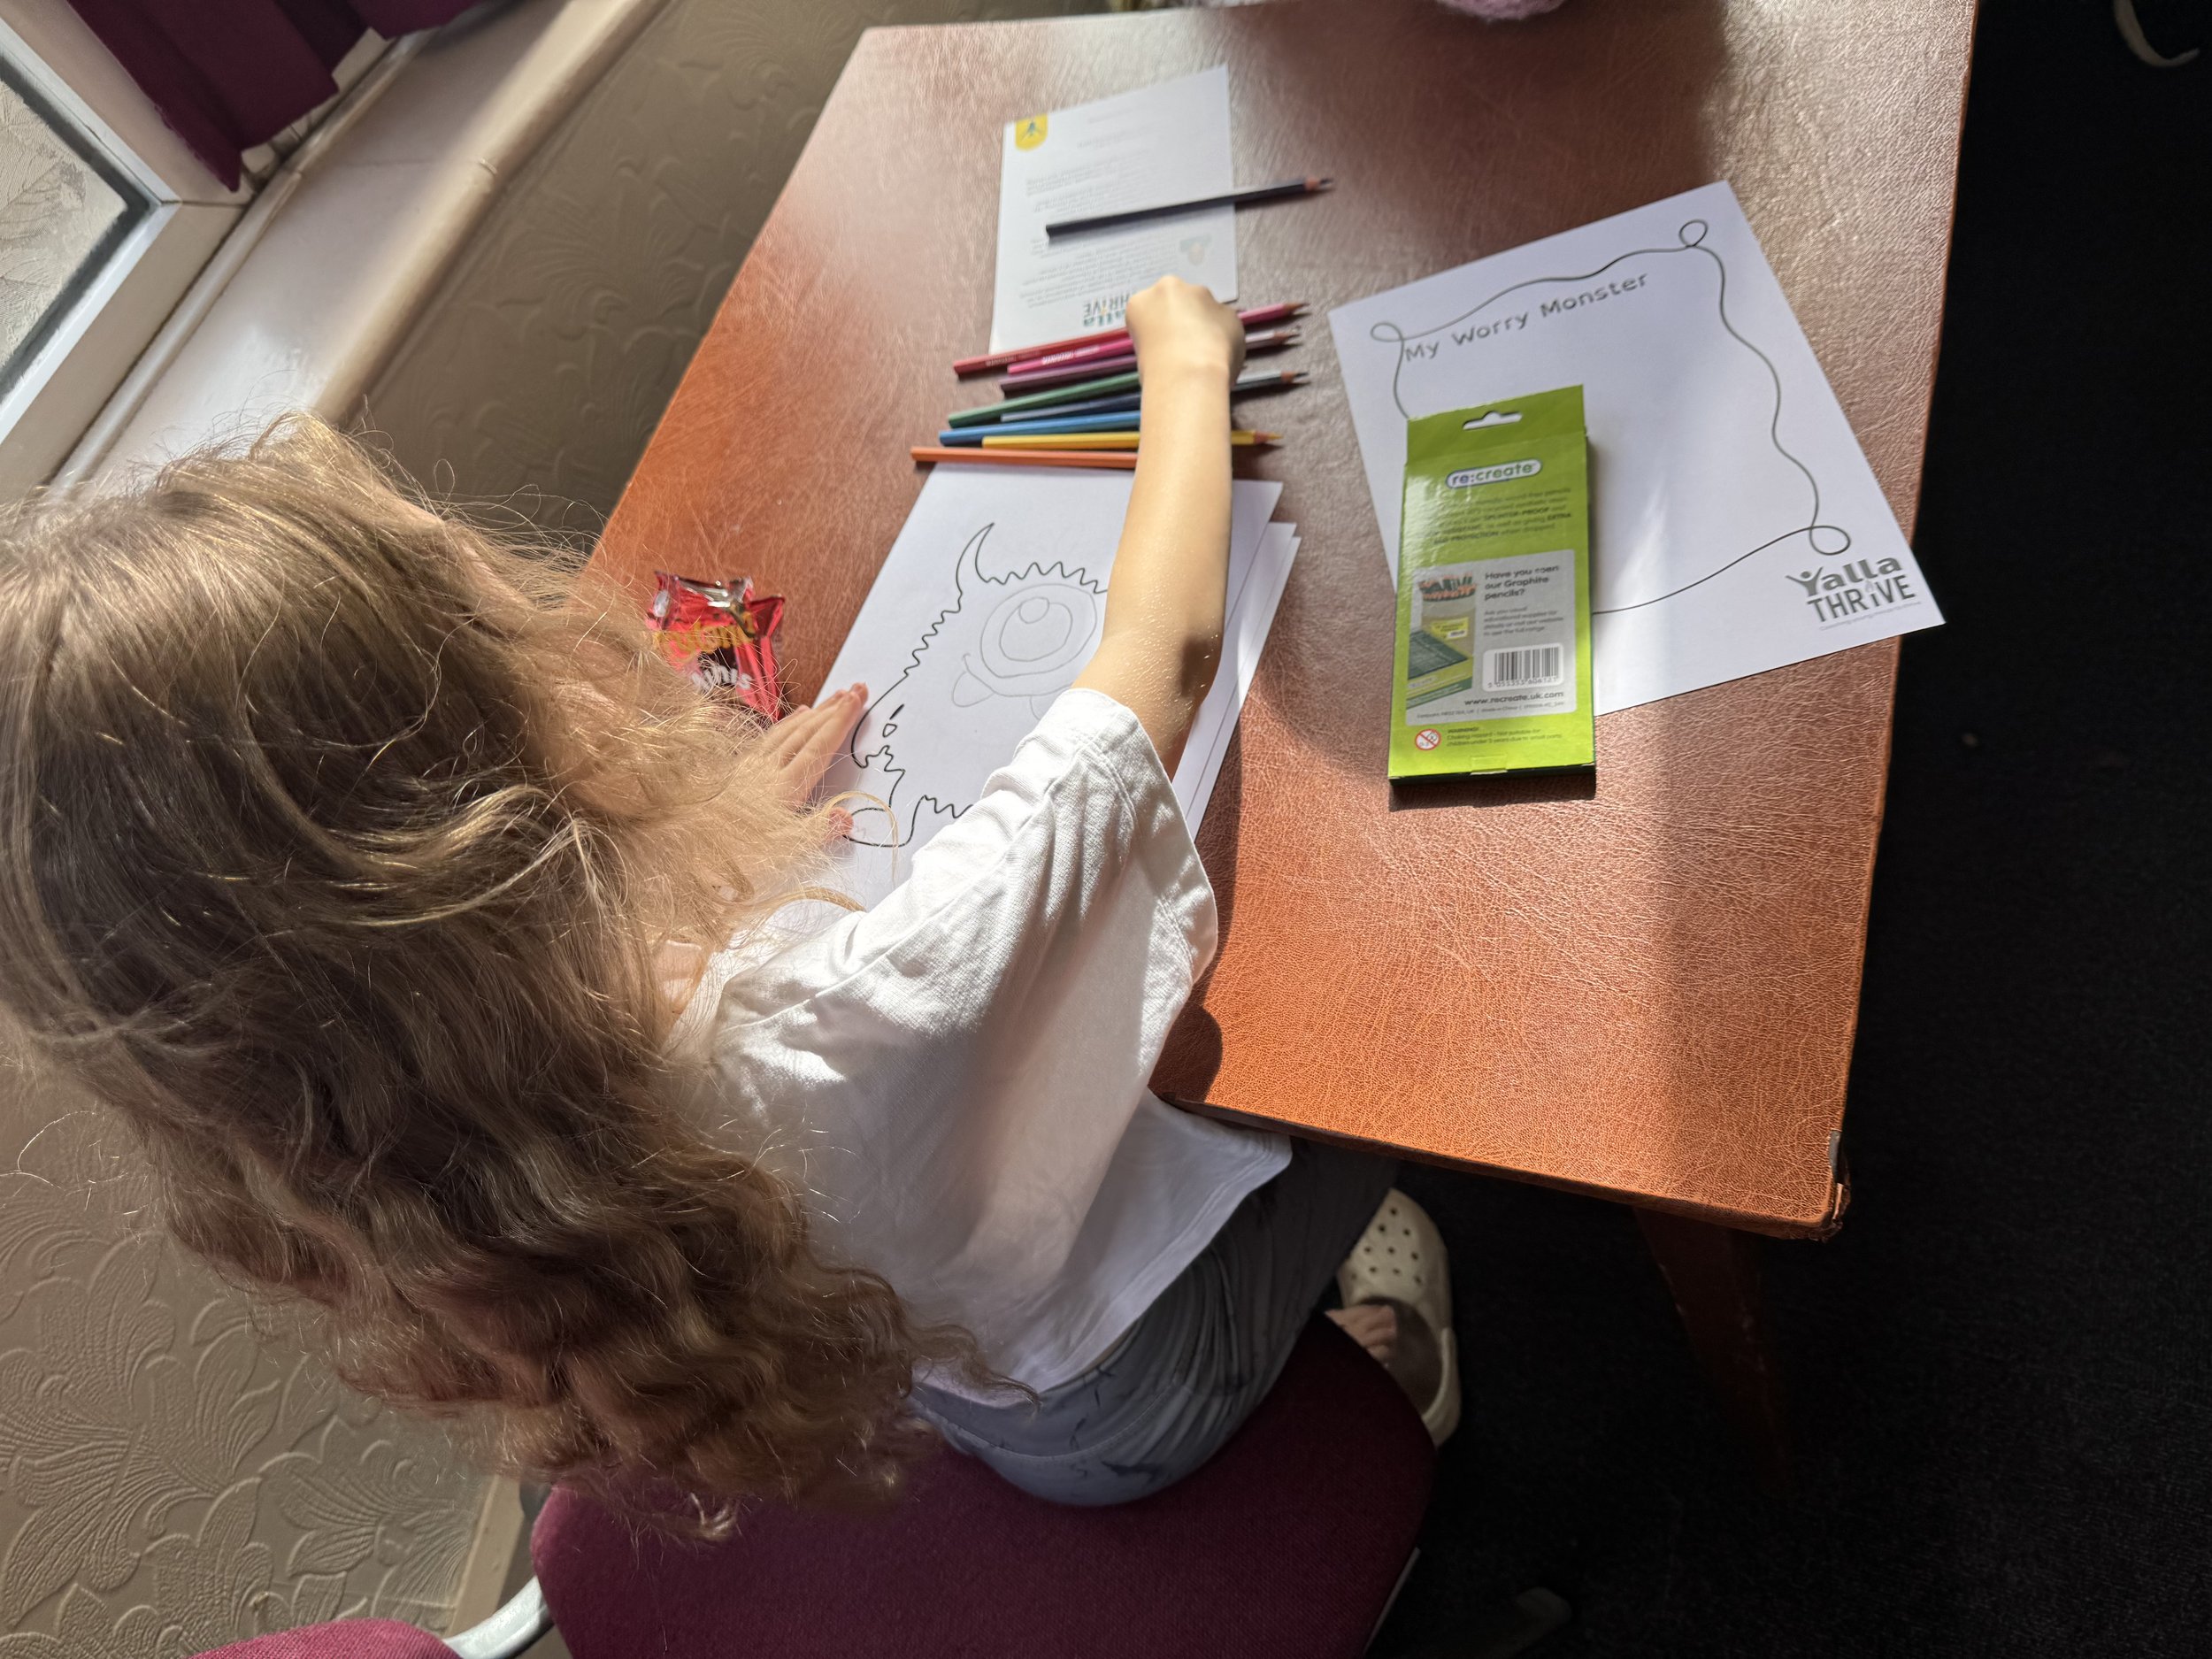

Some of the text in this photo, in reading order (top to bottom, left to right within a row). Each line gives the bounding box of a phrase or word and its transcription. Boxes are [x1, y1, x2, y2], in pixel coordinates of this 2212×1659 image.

[1405, 273, 1648, 362] My Worry Monster
[1451, 462, 1534, 486] re:create
[1485, 571, 1511, 580] Have
[1513, 569, 1532, 578] you
[1503, 576, 1549, 588] Graphite
[1785, 557, 1902, 597] Yalla
[1485, 588, 1525, 601] pencils?
